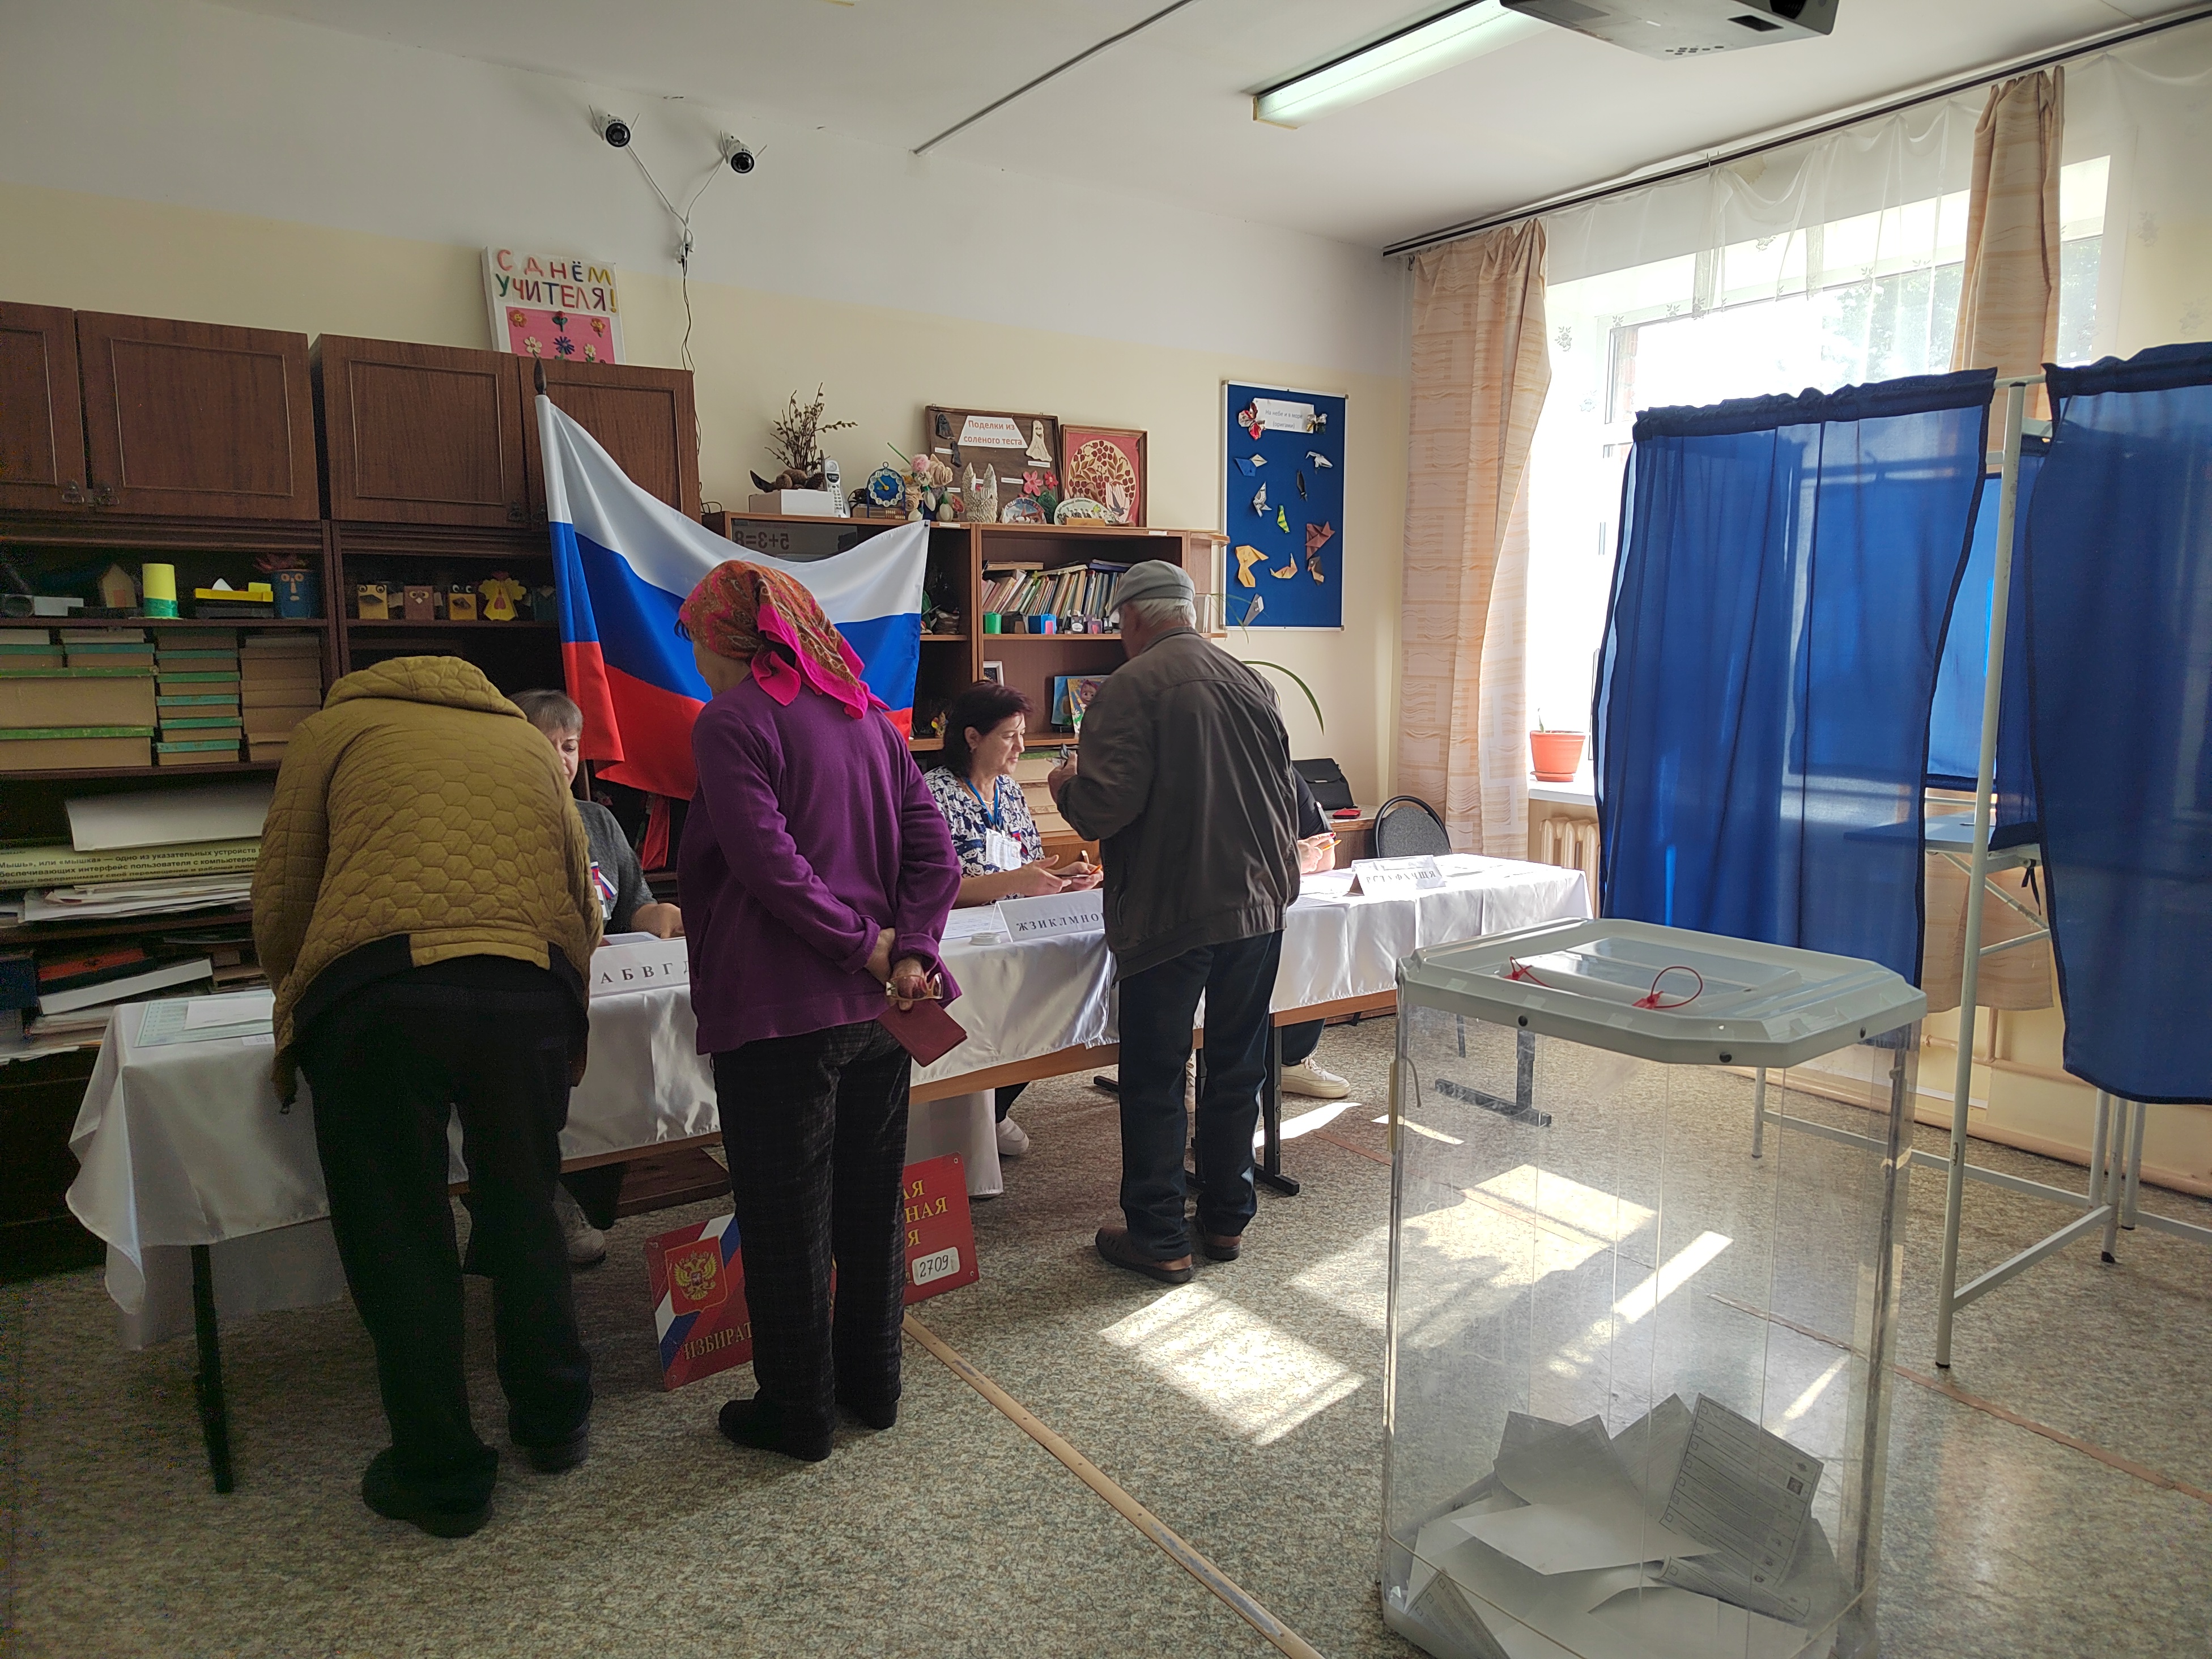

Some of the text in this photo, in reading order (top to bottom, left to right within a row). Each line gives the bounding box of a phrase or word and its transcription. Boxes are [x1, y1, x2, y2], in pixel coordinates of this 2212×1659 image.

[497, 249, 612, 286] С ДНЁМ
[496, 273, 617, 313] УЧИТЕЛЯ!
[968, 420, 1004, 430] Поделки
[1273, 420, 1295, 429] (оригами)
[963, 436, 1000, 444] соленого
[152, 851, 212, 861] указательных
[214, 848, 257, 857] устройств
[37, 874, 104, 883] воспринимает
[129, 867, 189, 877] перемещение
[198, 864, 233, 873] рабочей
[78, 865, 128, 874] интерфейс
[130, 861, 191, 870] пользователя
[201, 856, 257, 866] компьютером
[1016, 913, 1104, 931] ЖЗИКЛМНО
[919, 1254, 949, 1278] 2709
